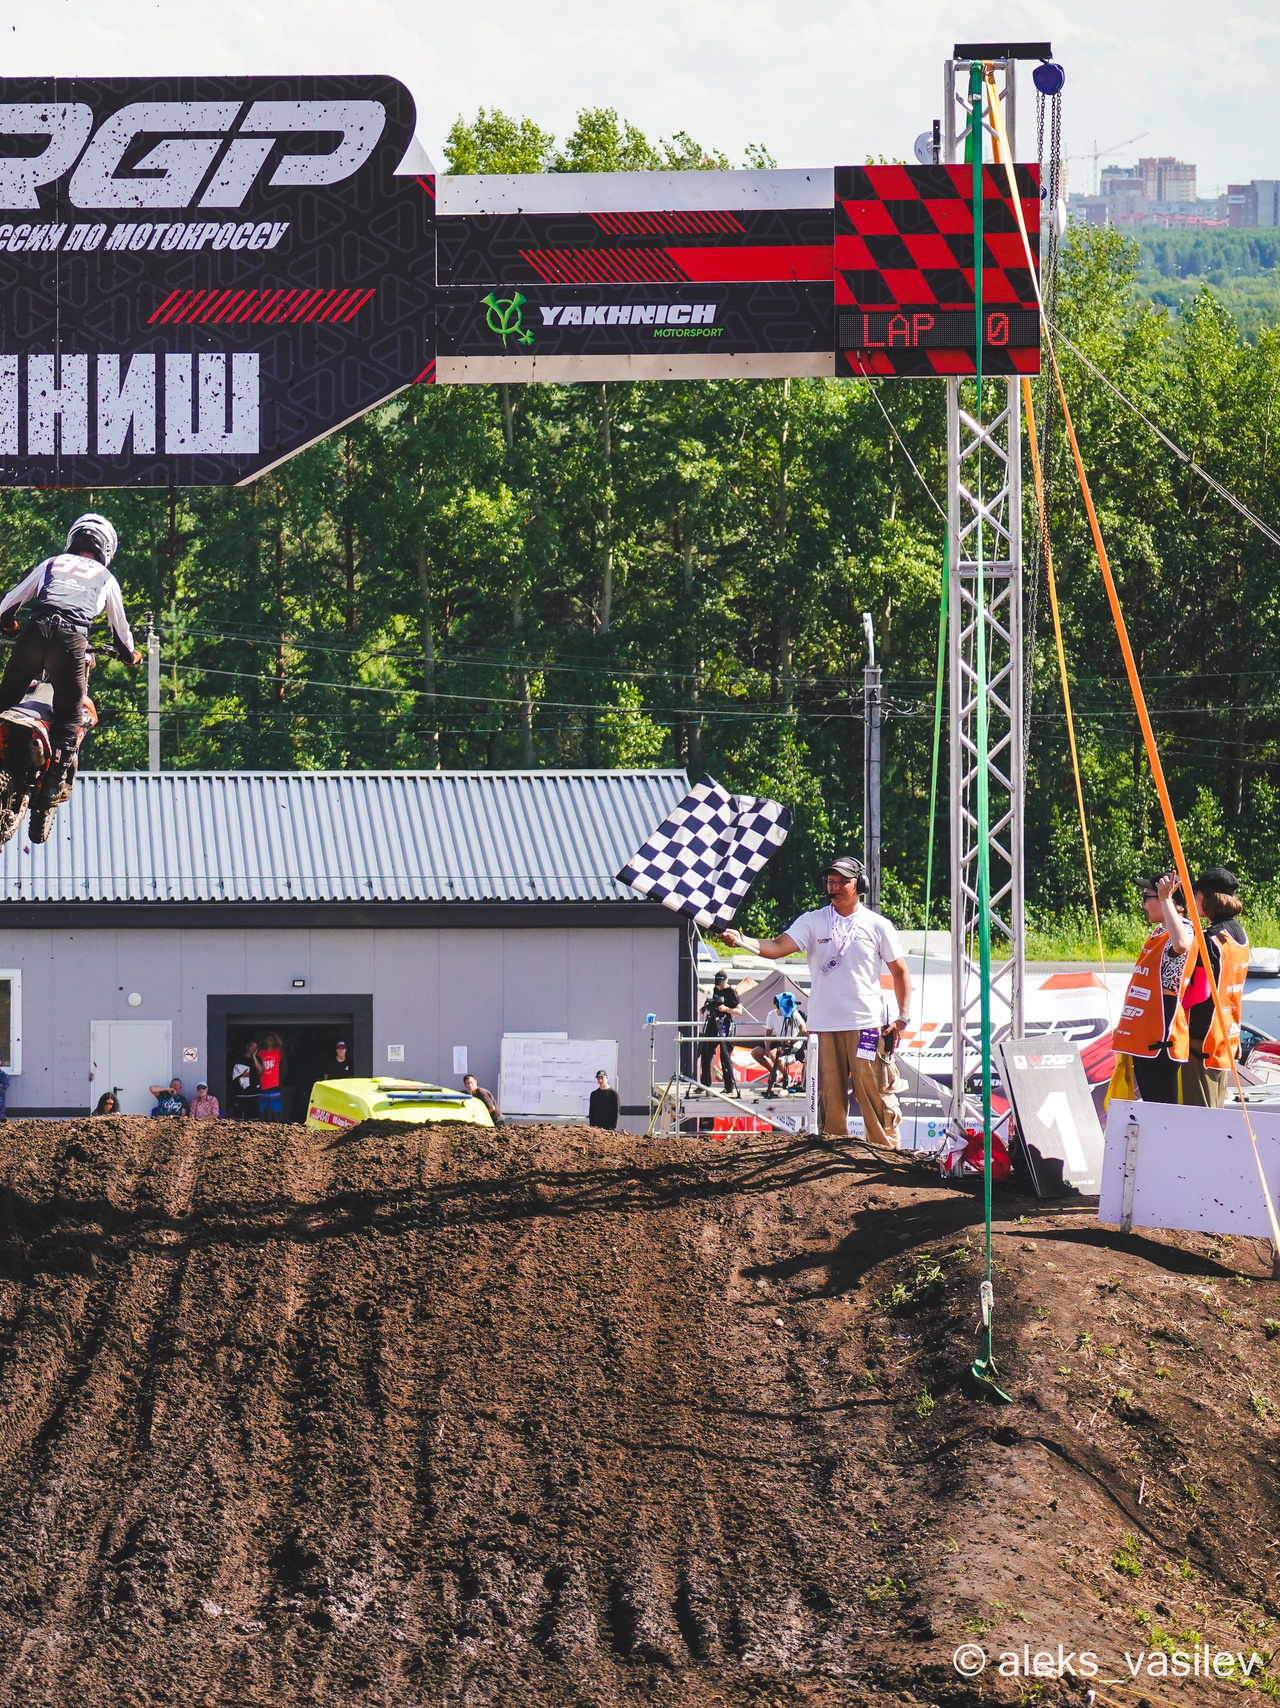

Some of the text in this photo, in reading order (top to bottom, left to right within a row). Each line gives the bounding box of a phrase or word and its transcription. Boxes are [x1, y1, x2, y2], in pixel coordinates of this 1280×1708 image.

[63, 223, 104, 251] ПО
[105, 222, 290, 251] МОТОКРОССУ
[539, 304, 717, 326] YAKHNICH
[863, 312, 1009, 347] LAP 0
[653, 328, 724, 338] MOTORSPORT
[1036, 1091, 1088, 1171] 1
